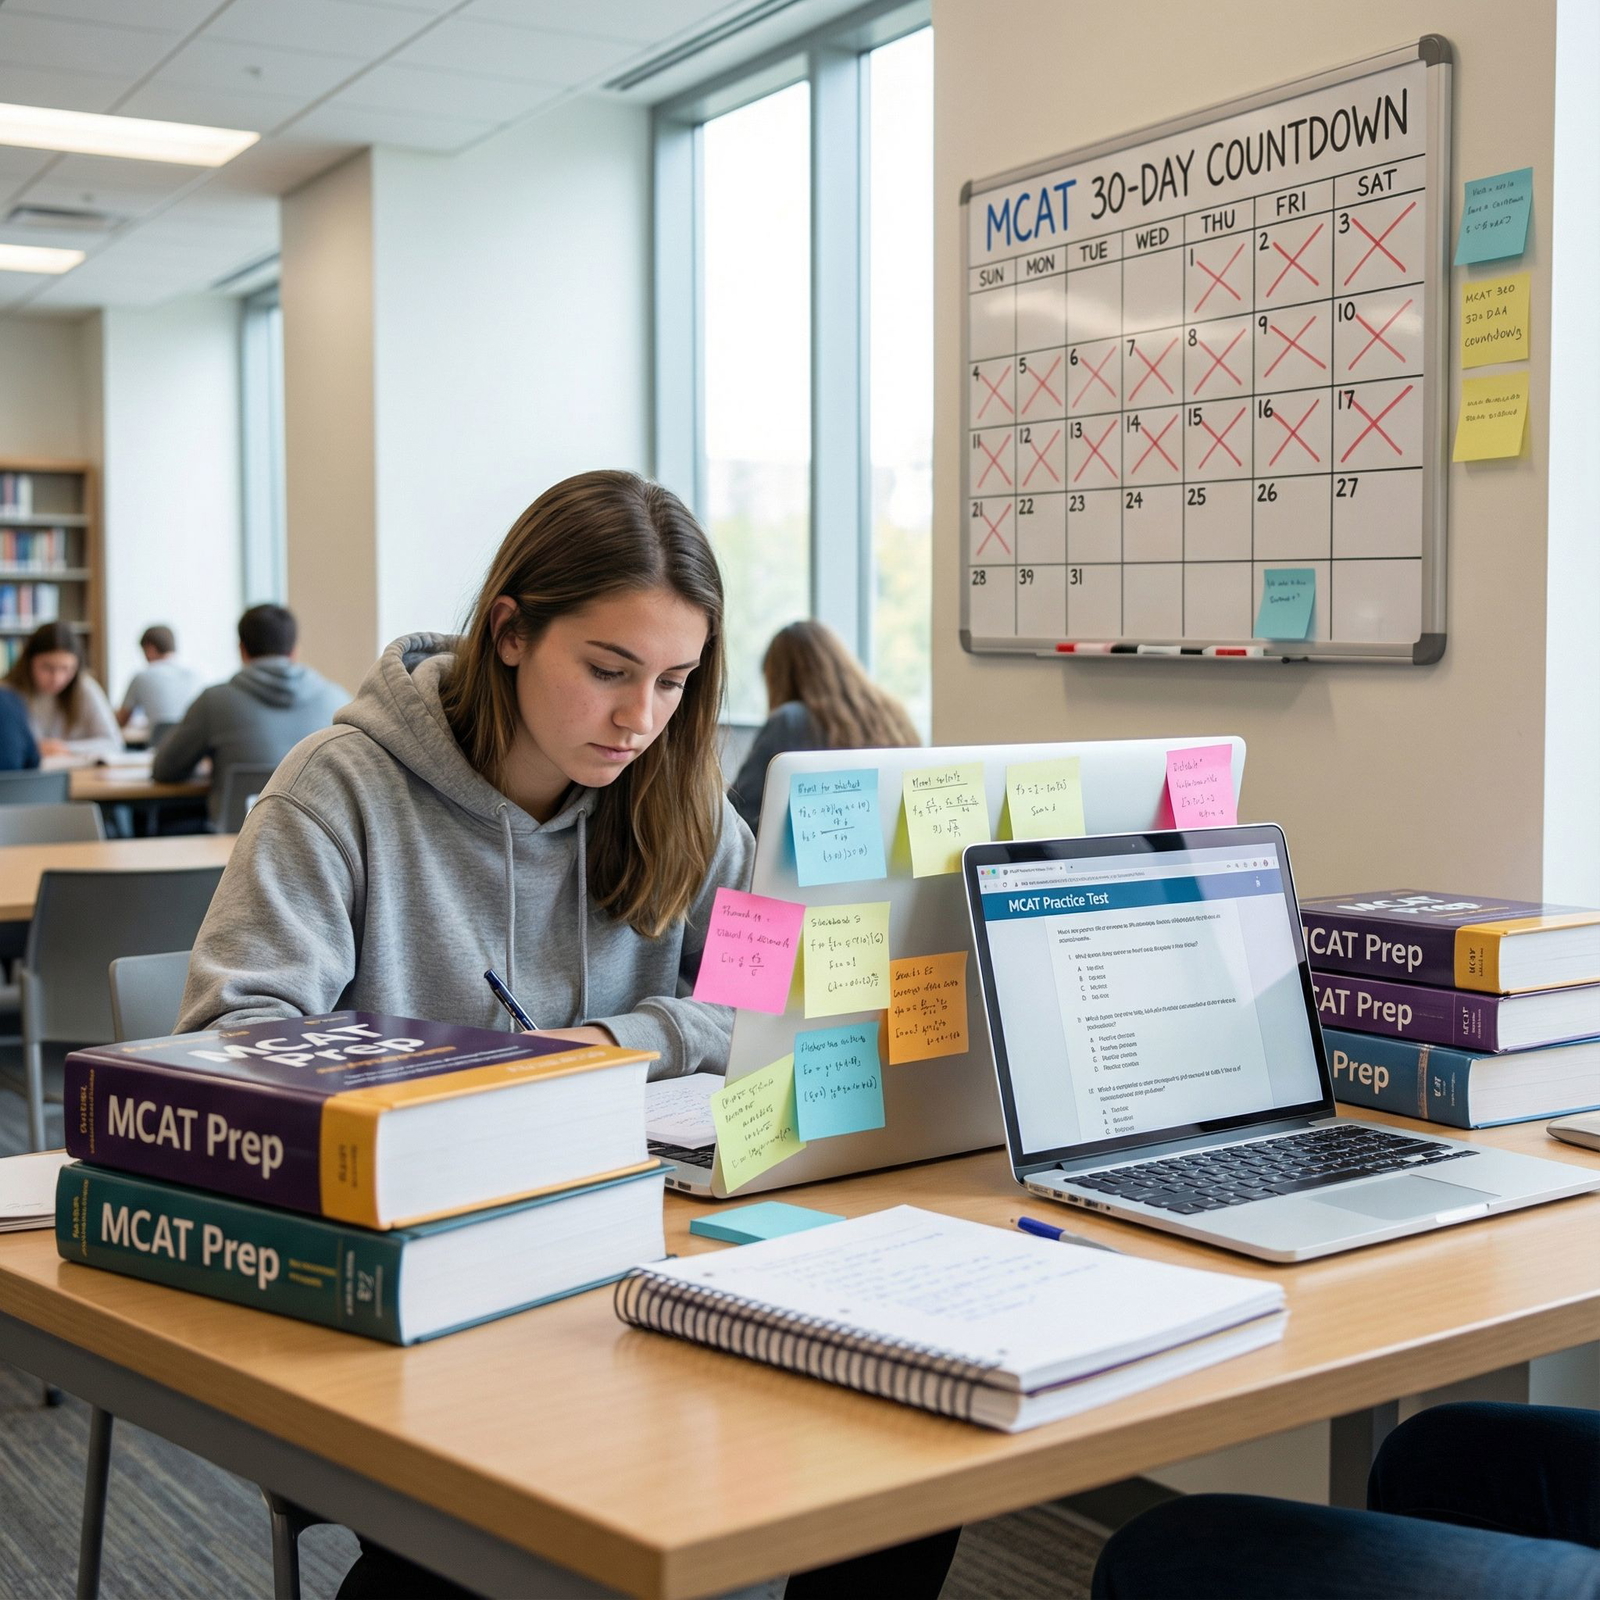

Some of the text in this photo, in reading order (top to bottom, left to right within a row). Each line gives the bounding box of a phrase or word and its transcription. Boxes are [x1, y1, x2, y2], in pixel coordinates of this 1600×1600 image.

[987, 87, 1408, 252] MCAT 30-DAY COUNTDOWN
[979, 168, 1398, 288] SUN MON TUE WED THU FRI SAT
[1190, 212, 1351, 268] 1 2 3
[972, 301, 1356, 382] 4 5 6 7 8 9 10
[972, 389, 1356, 449] 11 12 13 14 15 16 17
[972, 477, 1359, 518] 21 22 23 24 25 26 27
[972, 568, 1083, 586] 28 39 31
[1008, 892, 1110, 913] MCAT Practice Test
[1336, 895, 1444, 913] MCAT
[1365, 934, 1424, 973] Prep
[1357, 991, 1413, 1031] Prep
[187, 1023, 383, 1064] MCAT
[262, 1037, 426, 1069] Prep
[1333, 1049, 1390, 1095] Prep
[107, 1094, 199, 1152] MCAT
[206, 1112, 285, 1180] Prep
[100, 1201, 195, 1262] MCAT
[202, 1223, 281, 1290] Prep
